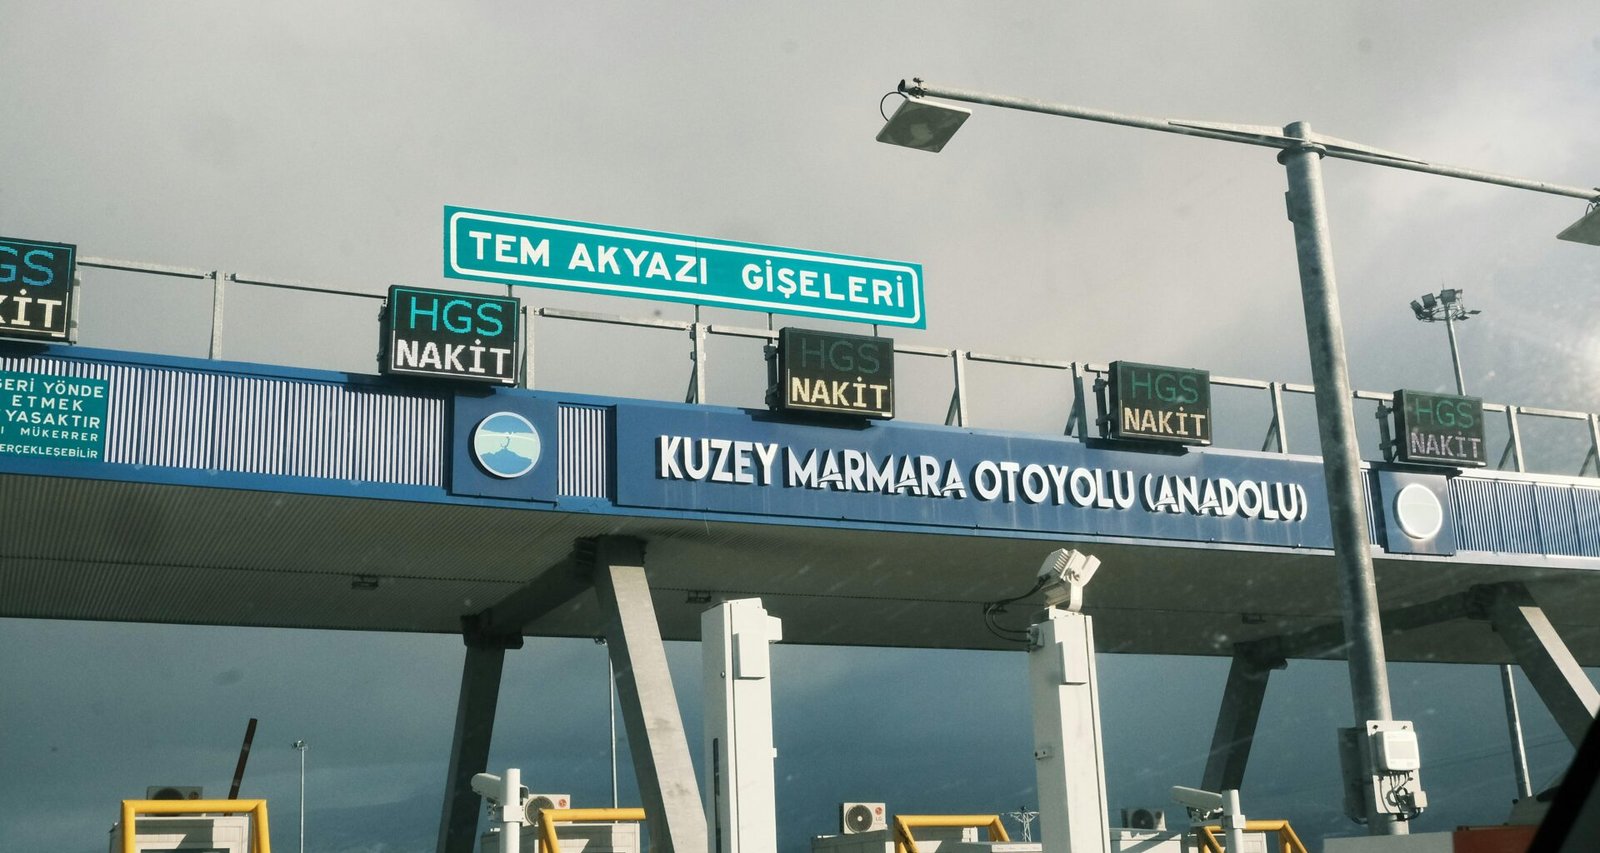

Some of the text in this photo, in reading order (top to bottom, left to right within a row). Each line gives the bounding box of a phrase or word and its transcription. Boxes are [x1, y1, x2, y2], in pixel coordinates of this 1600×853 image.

[469, 230, 904, 308] TEM AKYAZI GİŞELERİ
[410, 296, 503, 337] HGS
[396, 338, 511, 375] NAKİT
[801, 337, 880, 374] HGS
[0, 378, 104, 398] ERİ YÖNDE
[12, 394, 84, 412] ETMEK
[791, 376, 888, 409] NAKİT
[1131, 370, 1199, 404] HGS
[5, 409, 101, 429] YASAKTIR
[1124, 406, 1206, 437] NAKİT
[1415, 398, 1474, 428] HGS
[20, 426, 98, 442] MÜKERRER
[1411, 431, 1481, 459] NAKİT
[658, 434, 1308, 521] KUZEY MARMARA OTOYOLU (ANADOLU)
